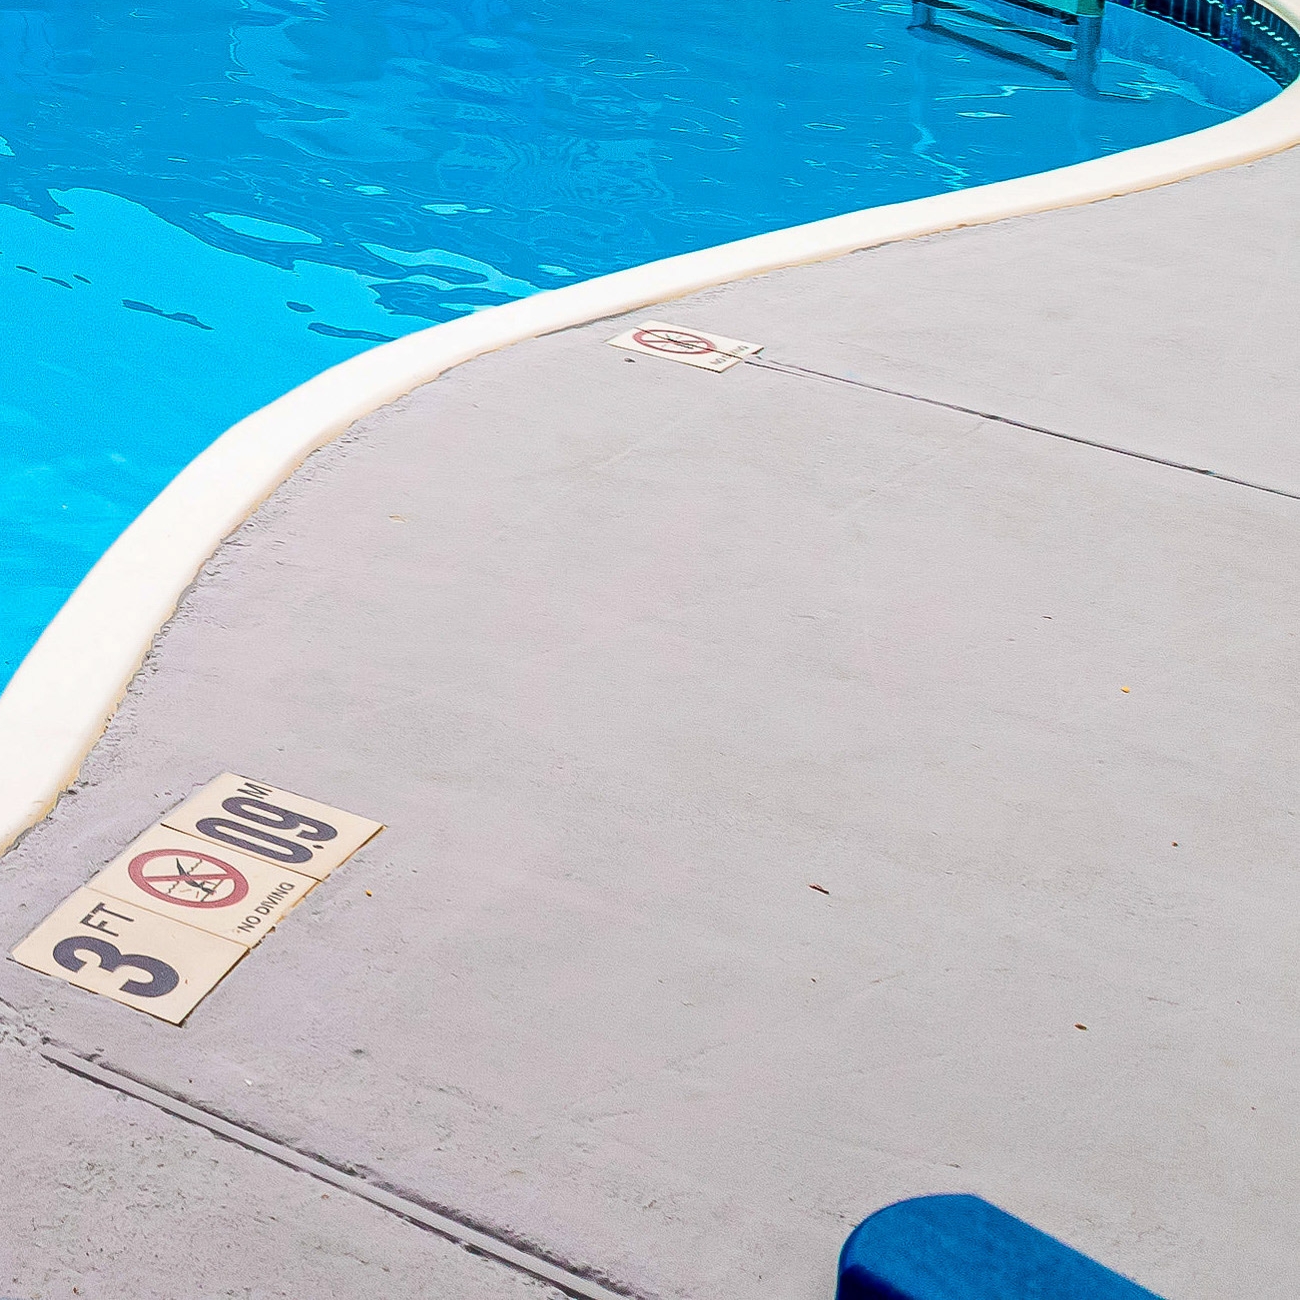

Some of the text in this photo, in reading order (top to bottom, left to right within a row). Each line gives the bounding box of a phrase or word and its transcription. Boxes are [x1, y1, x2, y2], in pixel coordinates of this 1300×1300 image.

[237, 782, 273, 799] M
[237, 881, 296, 933] NO DIVING
[52, 902, 180, 998] 3 FT
